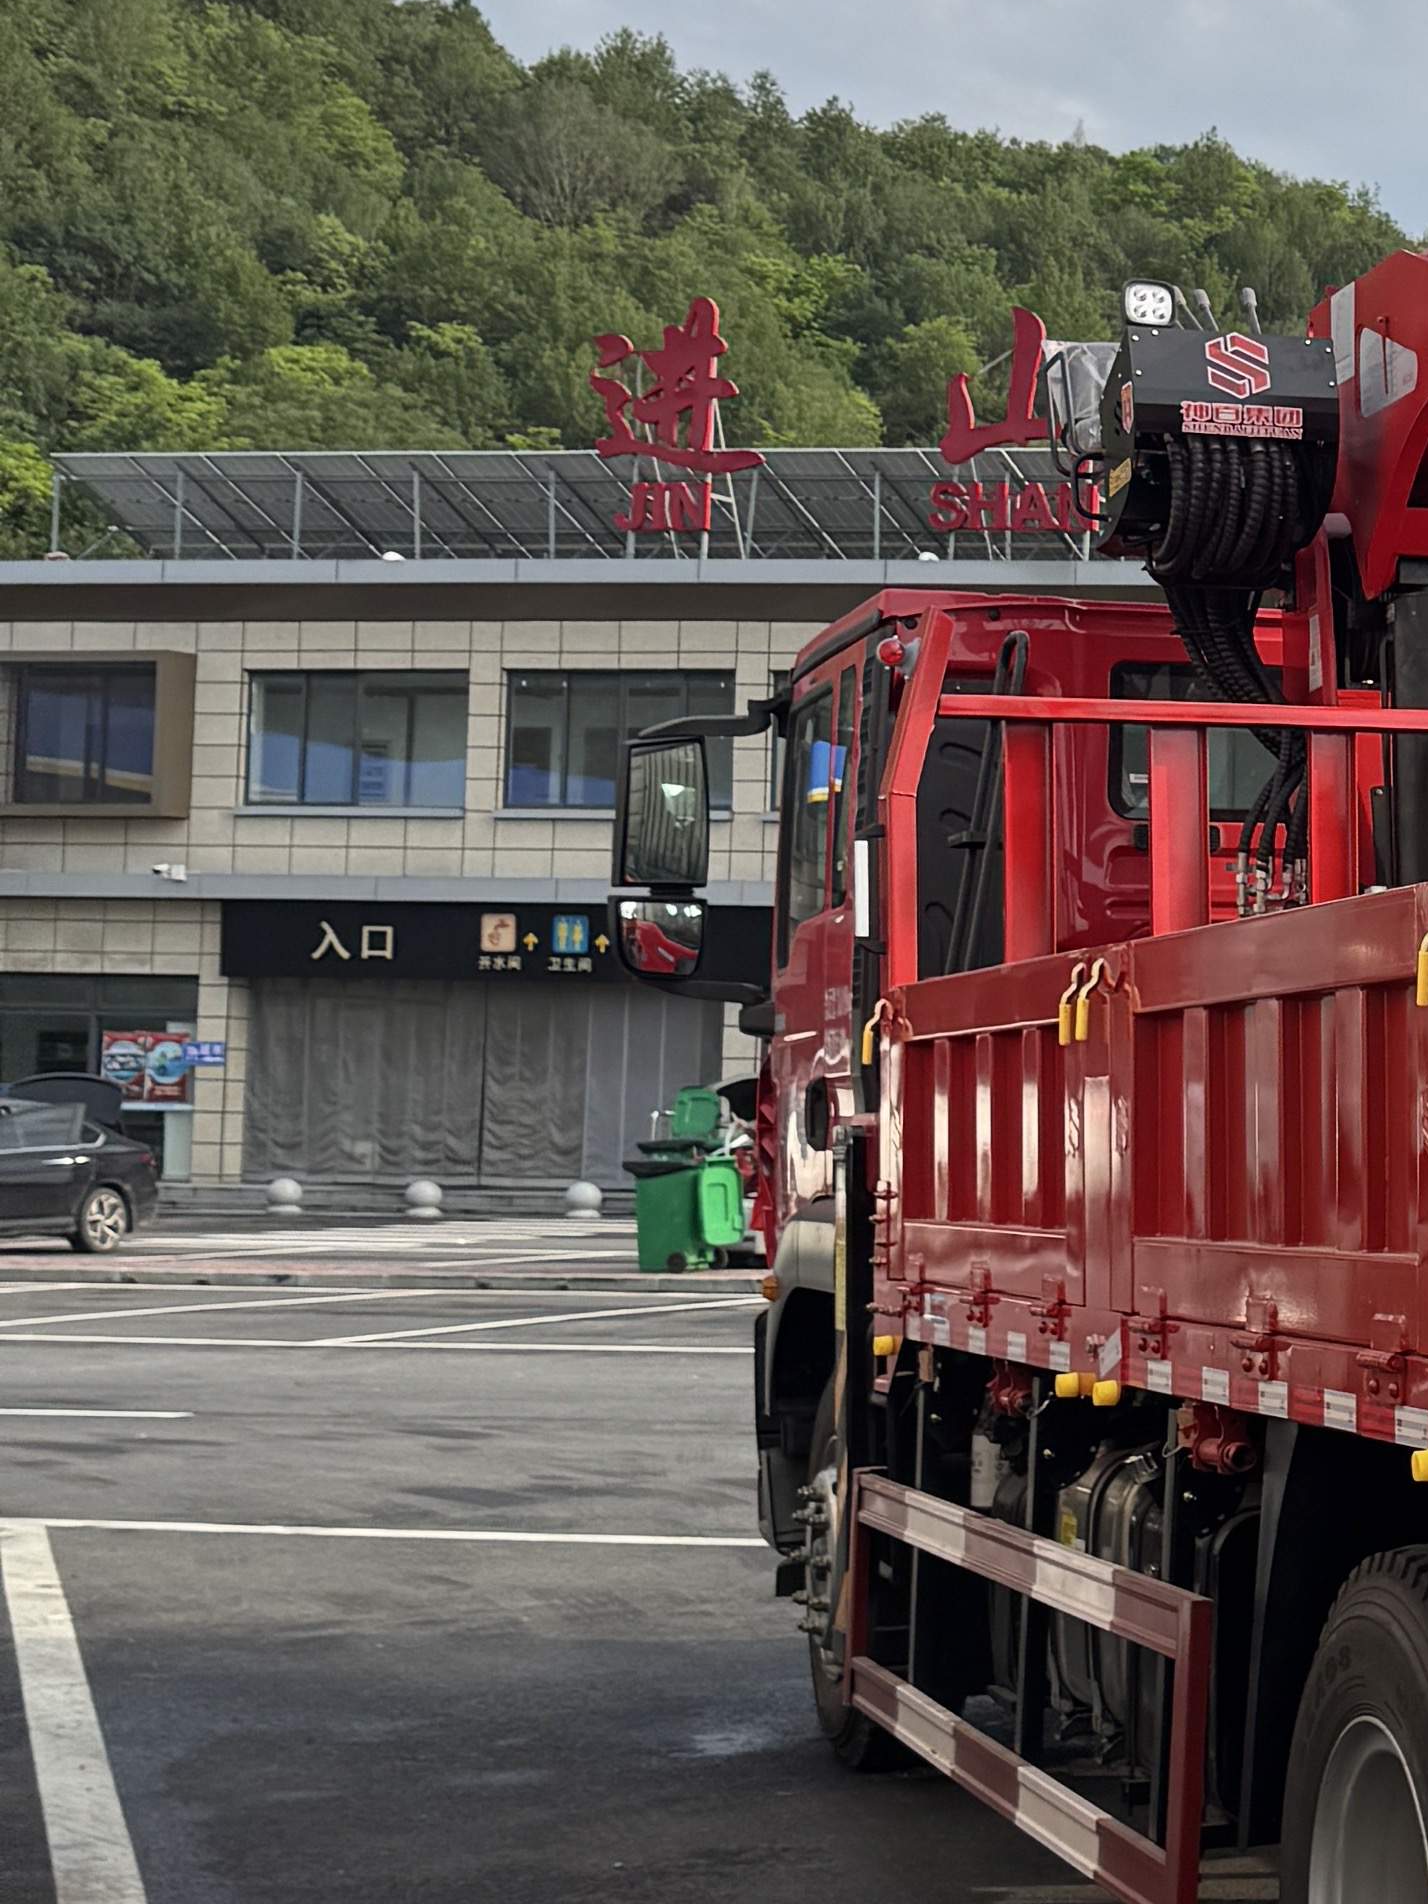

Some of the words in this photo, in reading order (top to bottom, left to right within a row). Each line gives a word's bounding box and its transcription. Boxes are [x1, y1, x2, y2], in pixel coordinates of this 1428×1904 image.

[590, 296, 765, 473] 进
[611, 482, 712, 530] JIN
[927, 481, 1099, 532] SHAN
[310, 920, 394, 960] 入口
[547, 957, 593, 973] 卫生间
